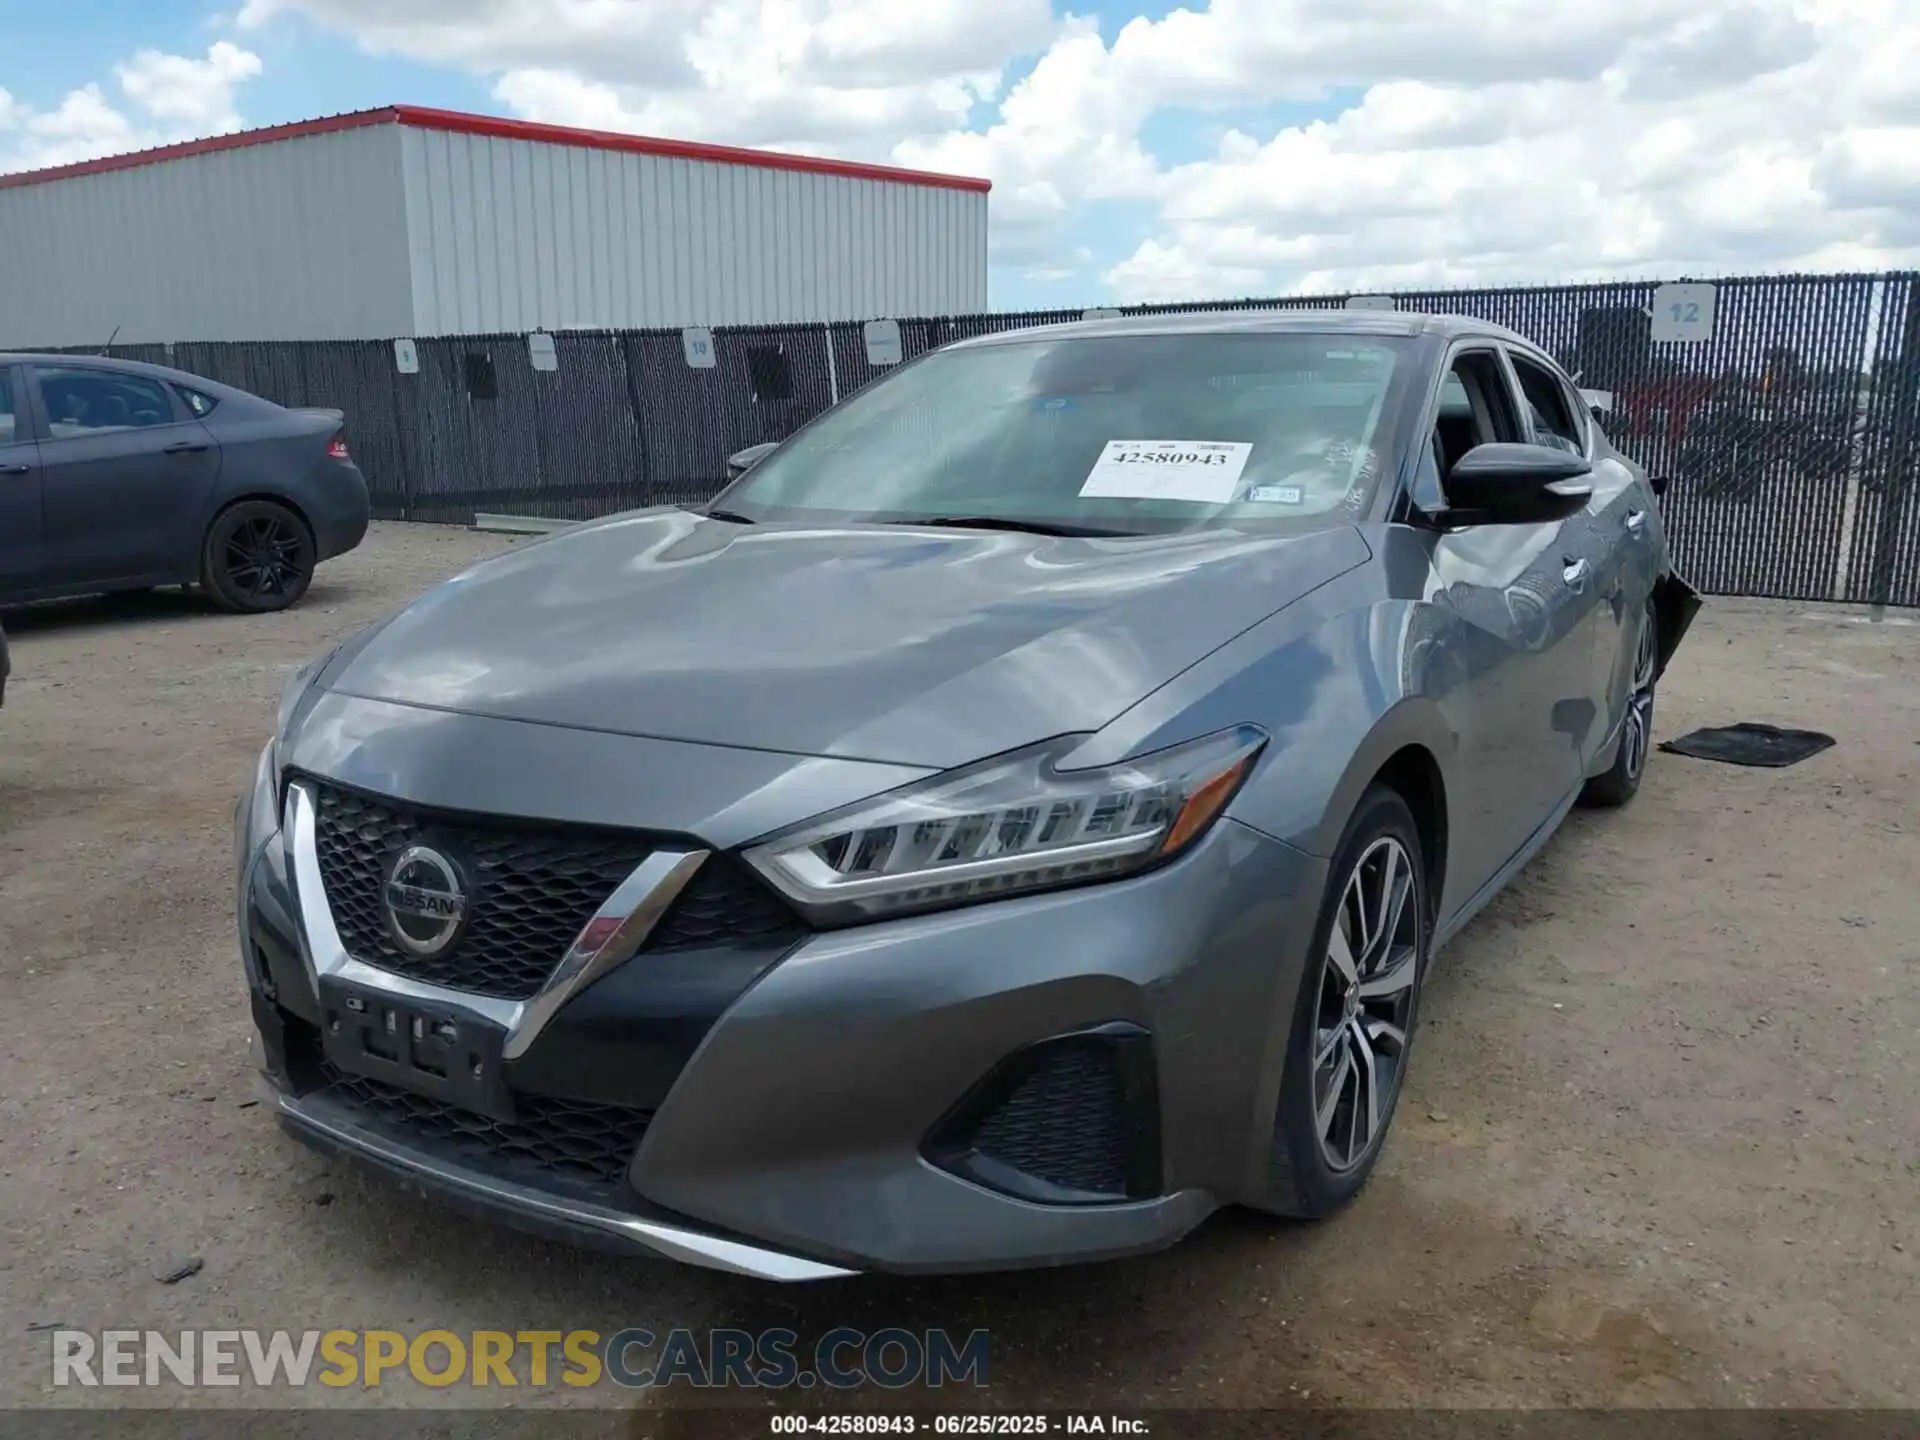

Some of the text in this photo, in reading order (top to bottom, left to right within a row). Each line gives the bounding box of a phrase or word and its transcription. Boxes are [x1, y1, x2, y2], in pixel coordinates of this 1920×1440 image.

[1669, 302, 1700, 323] 12
[1113, 452, 1227, 466] 42580943
[389, 888, 455, 914] NISSAN
